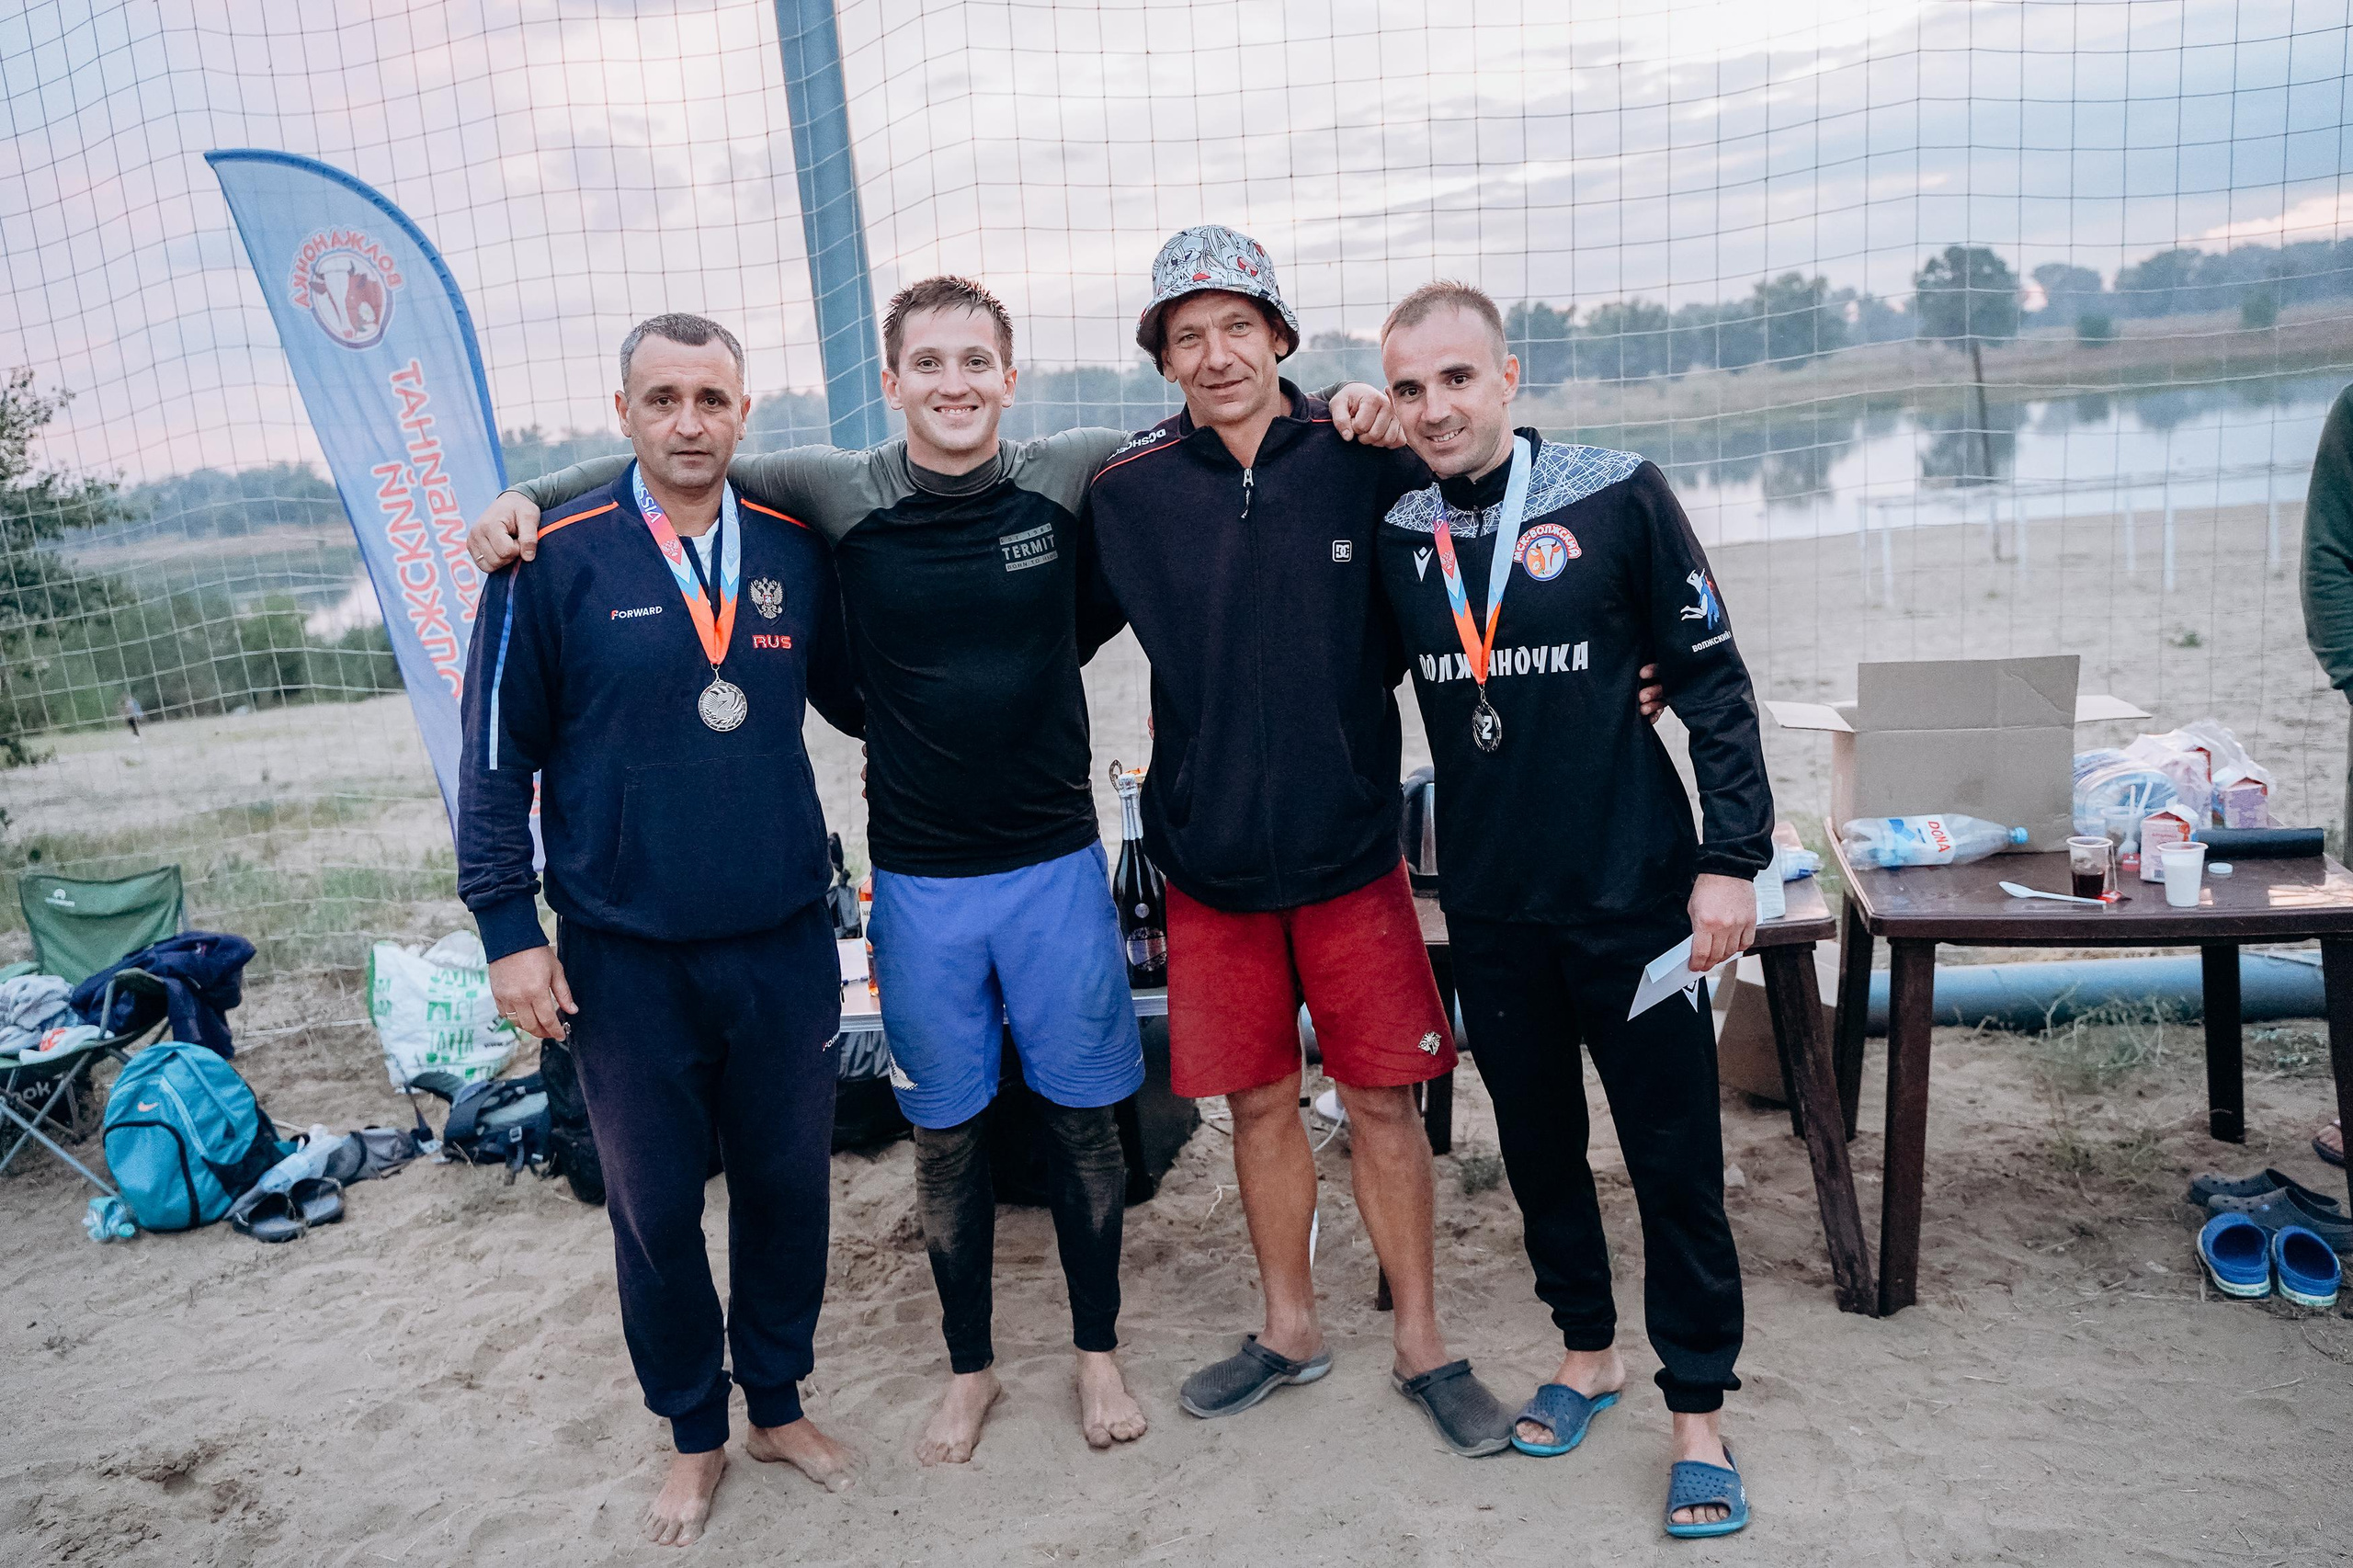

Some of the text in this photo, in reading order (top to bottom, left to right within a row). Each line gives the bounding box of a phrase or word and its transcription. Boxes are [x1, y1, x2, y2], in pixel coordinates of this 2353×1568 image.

[1001, 534, 1055, 561] TERMIT
[1512, 525, 1581, 562] МСК-ВОЛЖСКИЙ
[610, 606, 663, 620] FORWARD
[752, 634, 792, 650] RUS
[1482, 715, 1494, 740] 2
